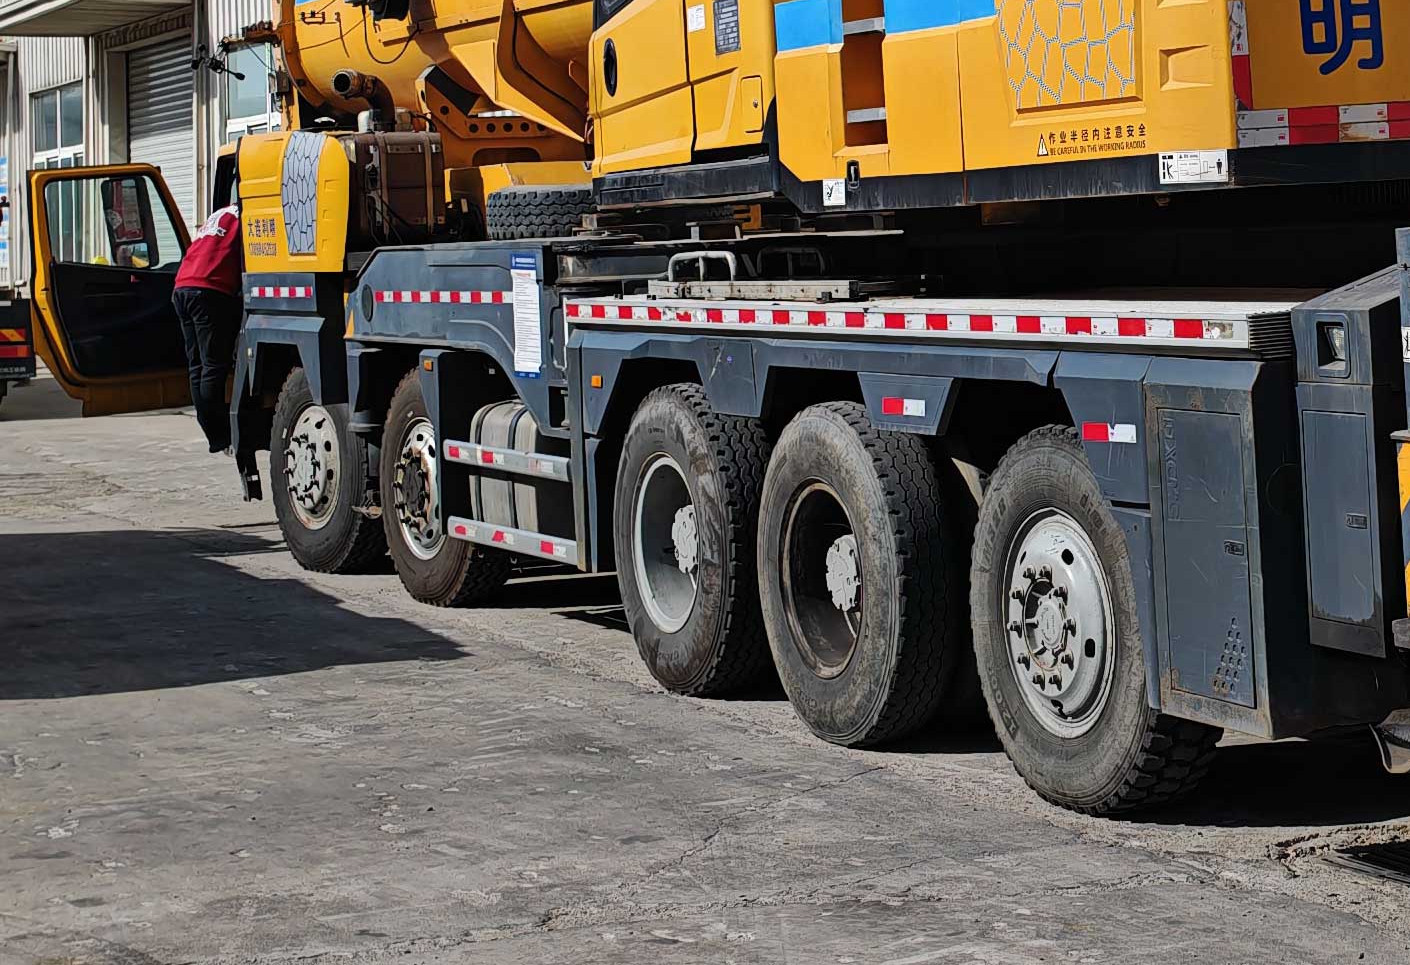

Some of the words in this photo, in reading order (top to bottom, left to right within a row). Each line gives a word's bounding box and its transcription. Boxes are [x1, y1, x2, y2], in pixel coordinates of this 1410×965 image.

[1048, 123, 1147, 145] 作业半径内注意安全
[1057, 145, 1079, 155] CAREFUL
[1087, 144, 1098, 153] THE
[1098, 141, 1125, 152] WORKING
